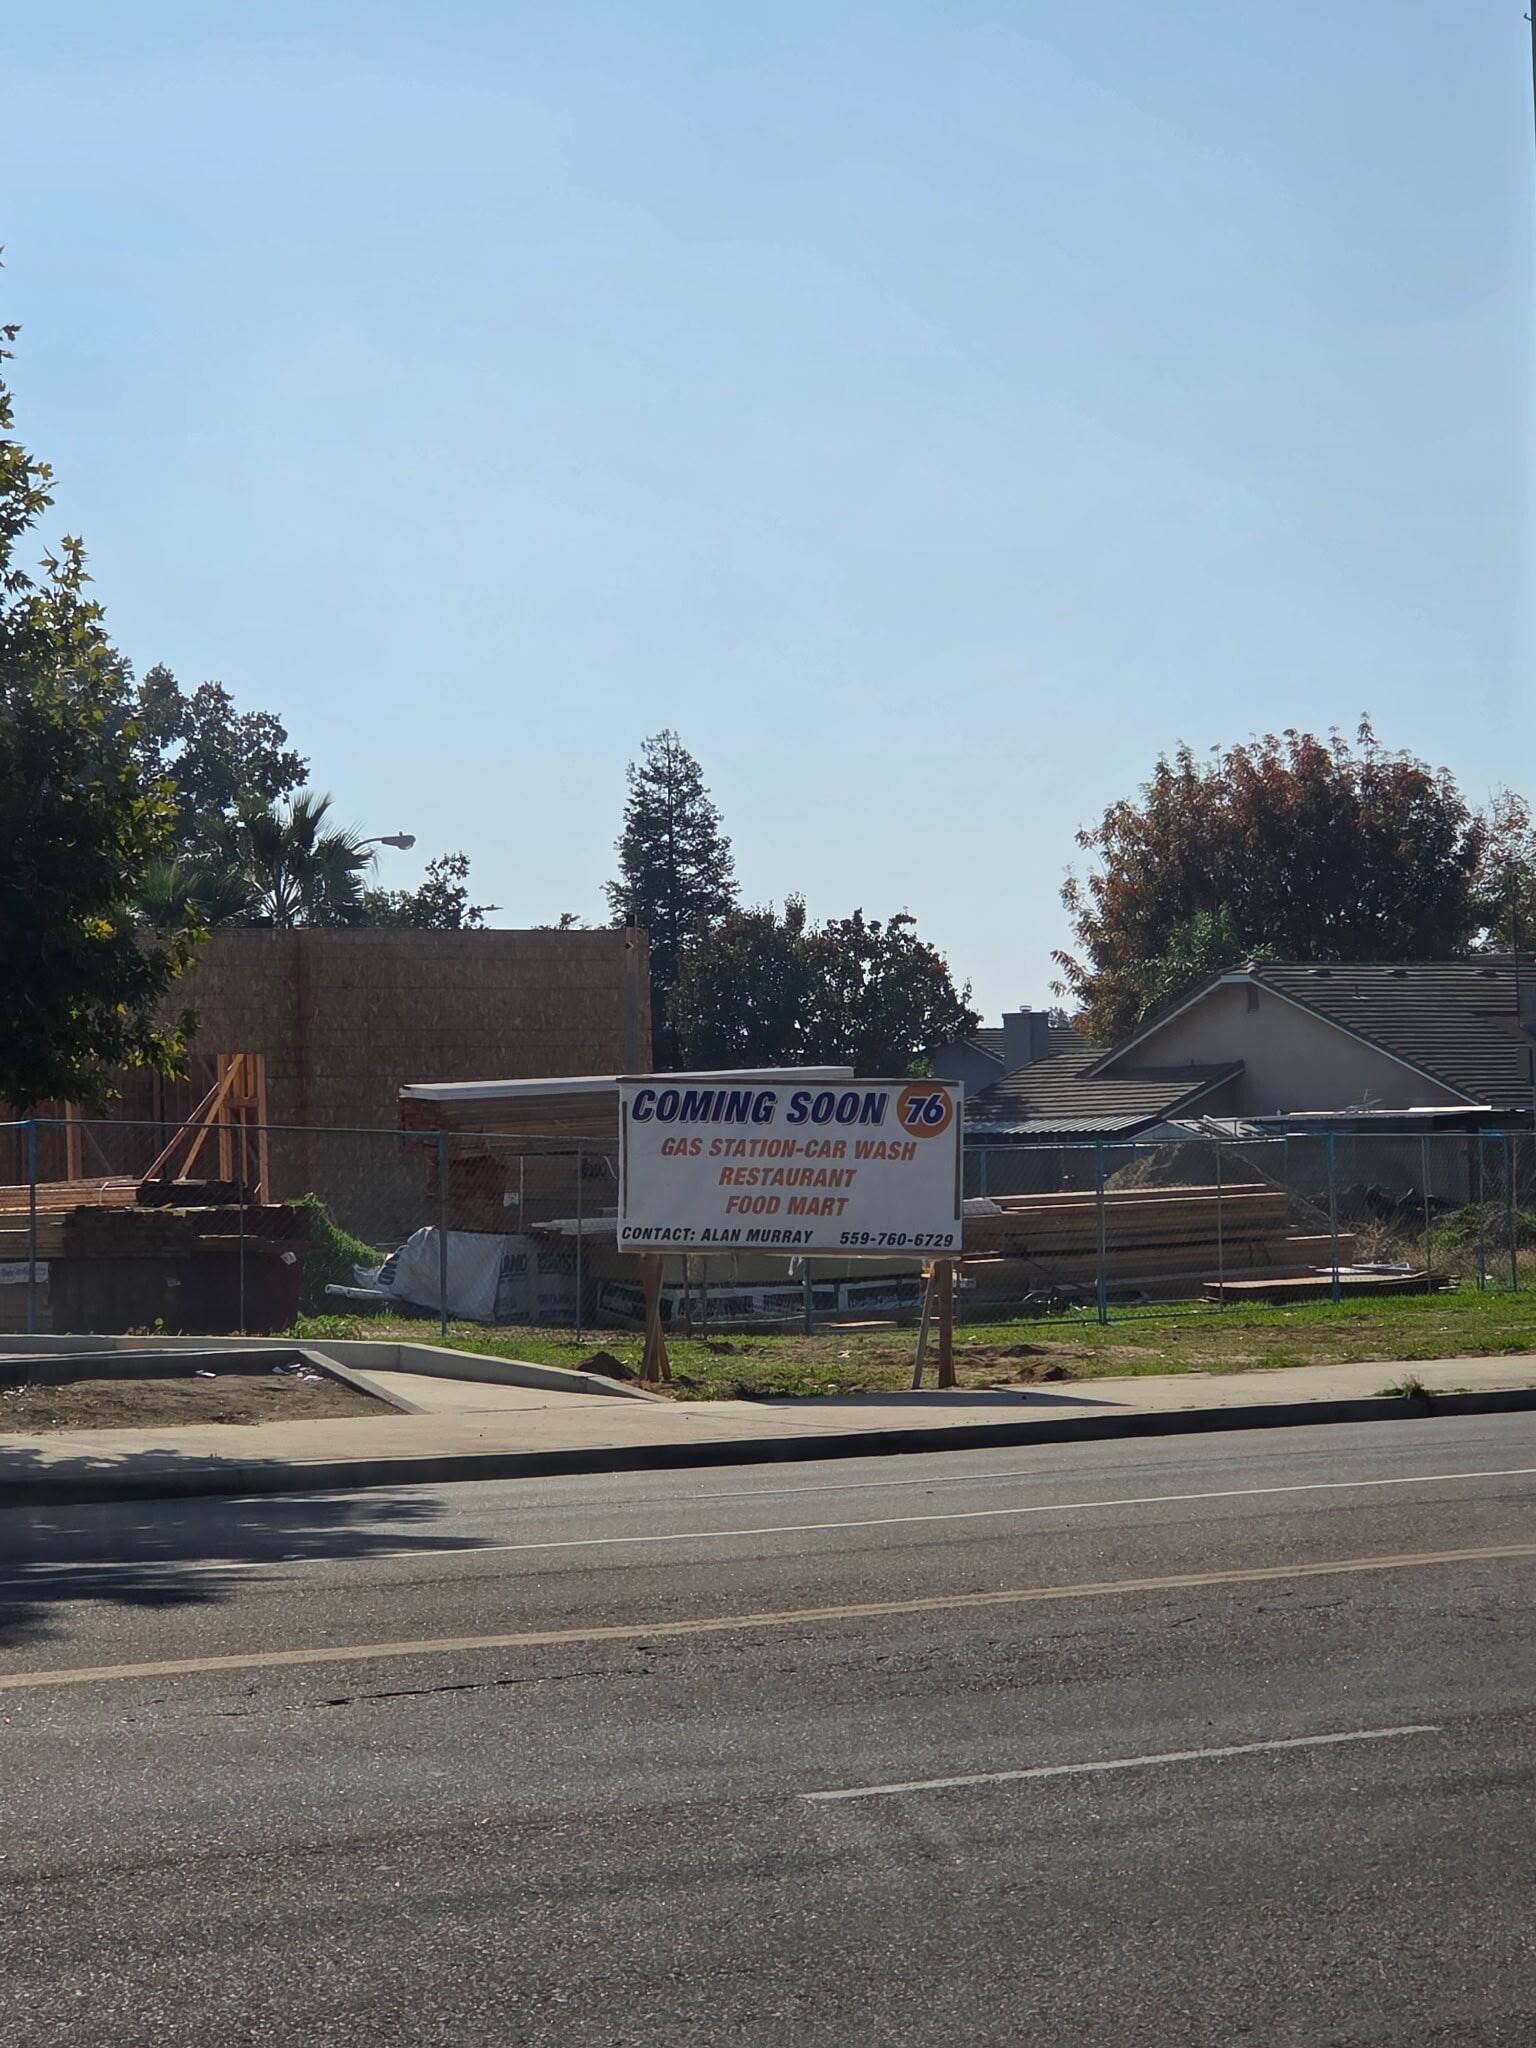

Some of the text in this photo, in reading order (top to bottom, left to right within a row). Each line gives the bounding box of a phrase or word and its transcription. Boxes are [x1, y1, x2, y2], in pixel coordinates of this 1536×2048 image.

[631, 1089, 889, 1126] COMING SOON
[905, 1092, 944, 1125] 76
[661, 1137, 917, 1160] GAS STATION-CAR WASH
[718, 1166, 856, 1187] RESTAURANT
[725, 1195, 848, 1216] FOOD MART
[621, 1226, 813, 1243] CONTACT: ALAN MURRAY
[839, 1231, 953, 1247] 559-760-6729
